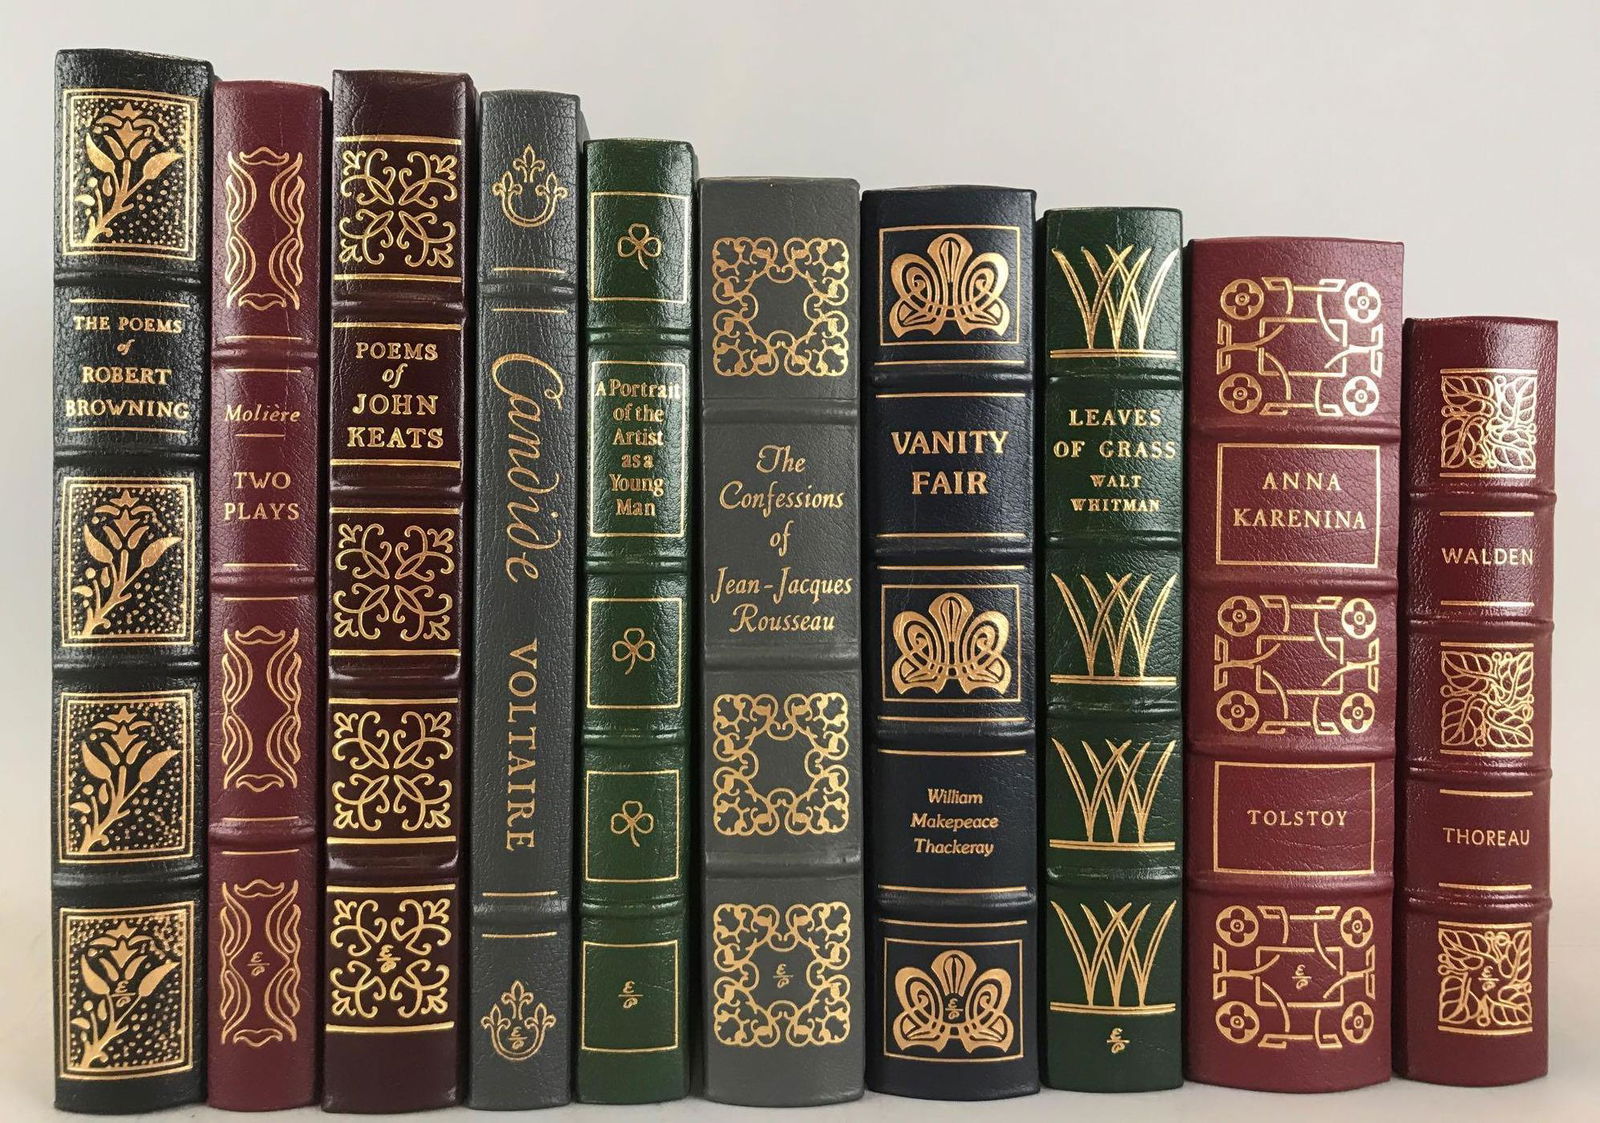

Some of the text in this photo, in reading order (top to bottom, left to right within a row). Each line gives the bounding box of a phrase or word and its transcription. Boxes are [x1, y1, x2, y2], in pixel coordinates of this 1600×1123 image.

[73, 315, 182, 333] THE POEMS
[117, 339, 134, 355] of
[355, 341, 439, 361] POEMS
[81, 366, 172, 385] ROBERT
[381, 363, 405, 388] of
[594, 378, 681, 399] A Portrait
[65, 399, 190, 420] BROWNING
[224, 404, 301, 423] Molière
[352, 393, 439, 416] JOHN
[612, 404, 665, 423] of the
[1068, 408, 1162, 427] LEAVES
[346, 426, 444, 449] KEATS
[612, 427, 664, 447] Artist
[890, 429, 1009, 455] VANITY
[755, 444, 806, 474] The
[1053, 440, 1177, 459] OF GRASS
[491, 352, 565, 584] Candide
[620, 453, 654, 468] as a
[233, 471, 291, 489] TWO
[609, 474, 665, 498] Young
[911, 471, 989, 495] FAIR
[1089, 474, 1142, 489] WALT
[1262, 471, 1343, 492] ANNA
[616, 500, 656, 517] Man
[718, 480, 845, 518] Confessions
[1070, 498, 1160, 512] WHITMAN
[224, 502, 300, 521] PLAYS
[1232, 507, 1367, 530] KARENINA
[768, 520, 795, 558] of
[1440, 547, 1534, 567] WALDEN
[710, 566, 854, 605] Jean-Jacques
[728, 603, 835, 633] Rousseau
[505, 637, 538, 852] VOLTAIRE
[926, 787, 984, 806] William
[910, 811, 1000, 832] Makepeace
[1246, 808, 1349, 828] TOLSTOY
[1441, 826, 1532, 847] THOREAU
[913, 837, 995, 857] Thackeray
